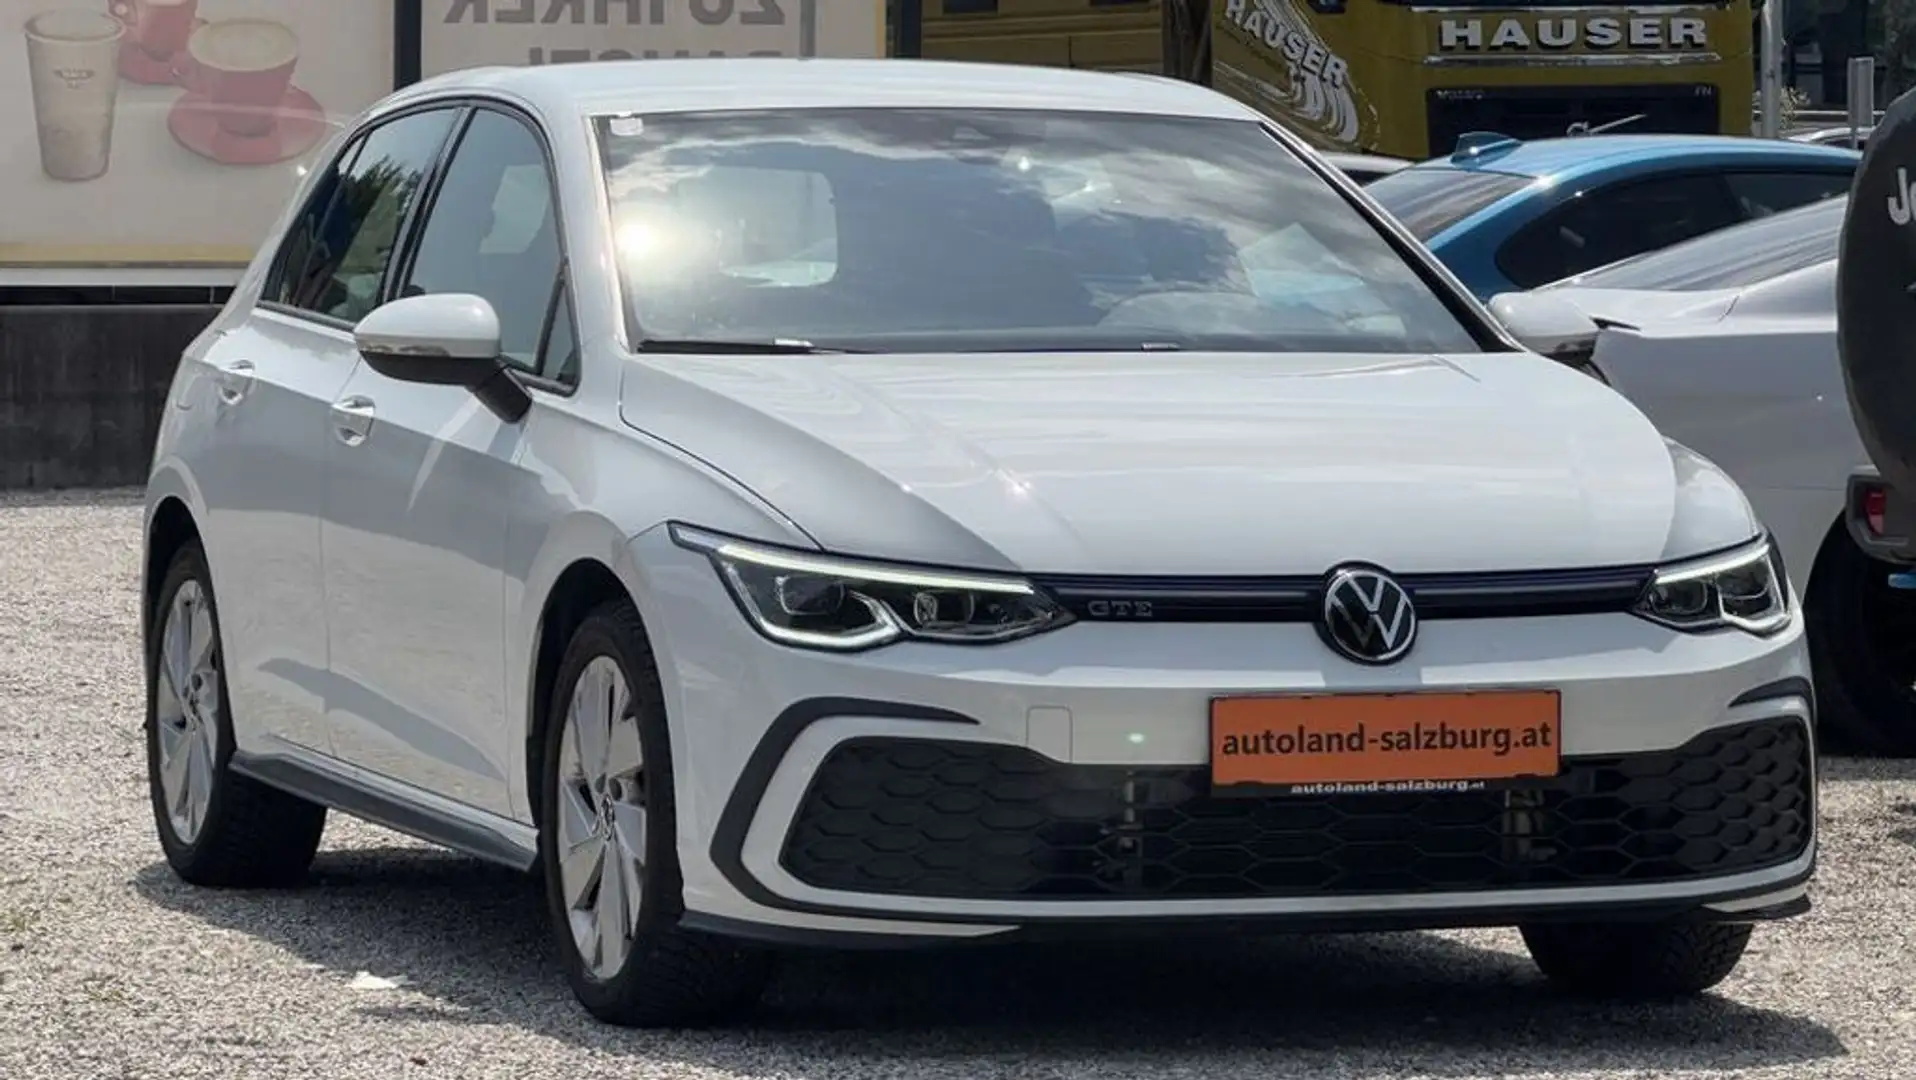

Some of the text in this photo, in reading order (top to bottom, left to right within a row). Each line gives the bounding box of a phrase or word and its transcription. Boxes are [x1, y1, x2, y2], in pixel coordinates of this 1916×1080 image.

[1225, 0, 1349, 89] HAUSER
[1439, 17, 1708, 48] HAUSER
[1887, 166, 1916, 225] J
[1087, 600, 1153, 617] GTE
[1222, 721, 1552, 757] autoland-salzburg.at
[1290, 779, 1486, 795] autoland-salzburg.at
